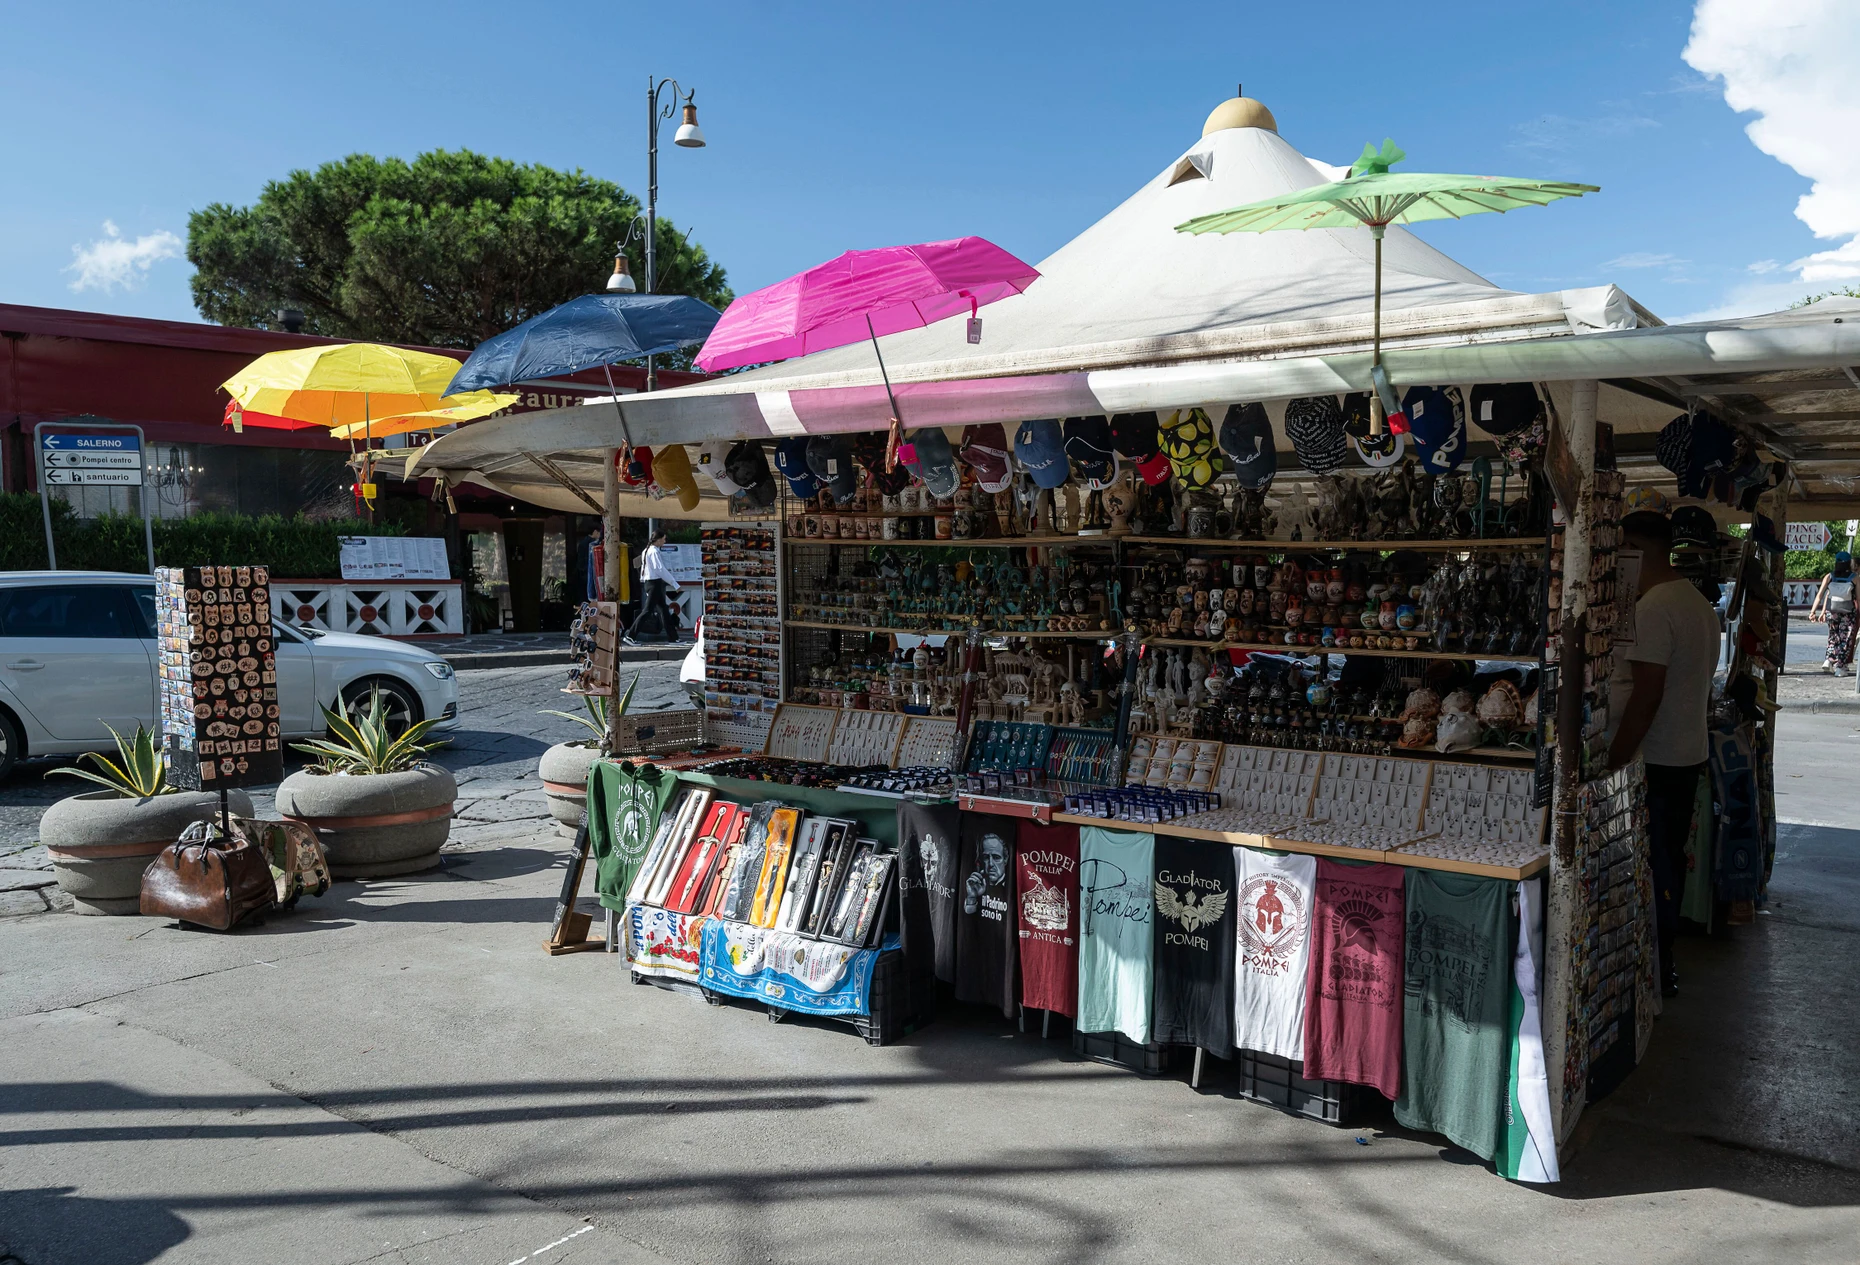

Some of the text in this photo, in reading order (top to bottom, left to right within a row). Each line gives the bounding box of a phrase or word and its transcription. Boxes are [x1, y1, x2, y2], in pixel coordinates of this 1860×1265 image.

[77, 439, 122, 447] SALERNO
[82, 456, 108, 465] Pompei
[1019, 850, 1076, 873] POMPEI
[1158, 870, 1222, 892] GLADIATOR
[1329, 885, 1389, 904] POMPEI
[1032, 931, 1062, 944] ANTICA
[1165, 933, 1209, 951] POMPEI
[1242, 954, 1290, 973] POMPEI
[1409, 948, 1475, 977] POMPEI
[1252, 967, 1279, 977] ITALIA
[1421, 965, 1460, 982] ITALIA
[1328, 982, 1384, 999] GLADIATOR
